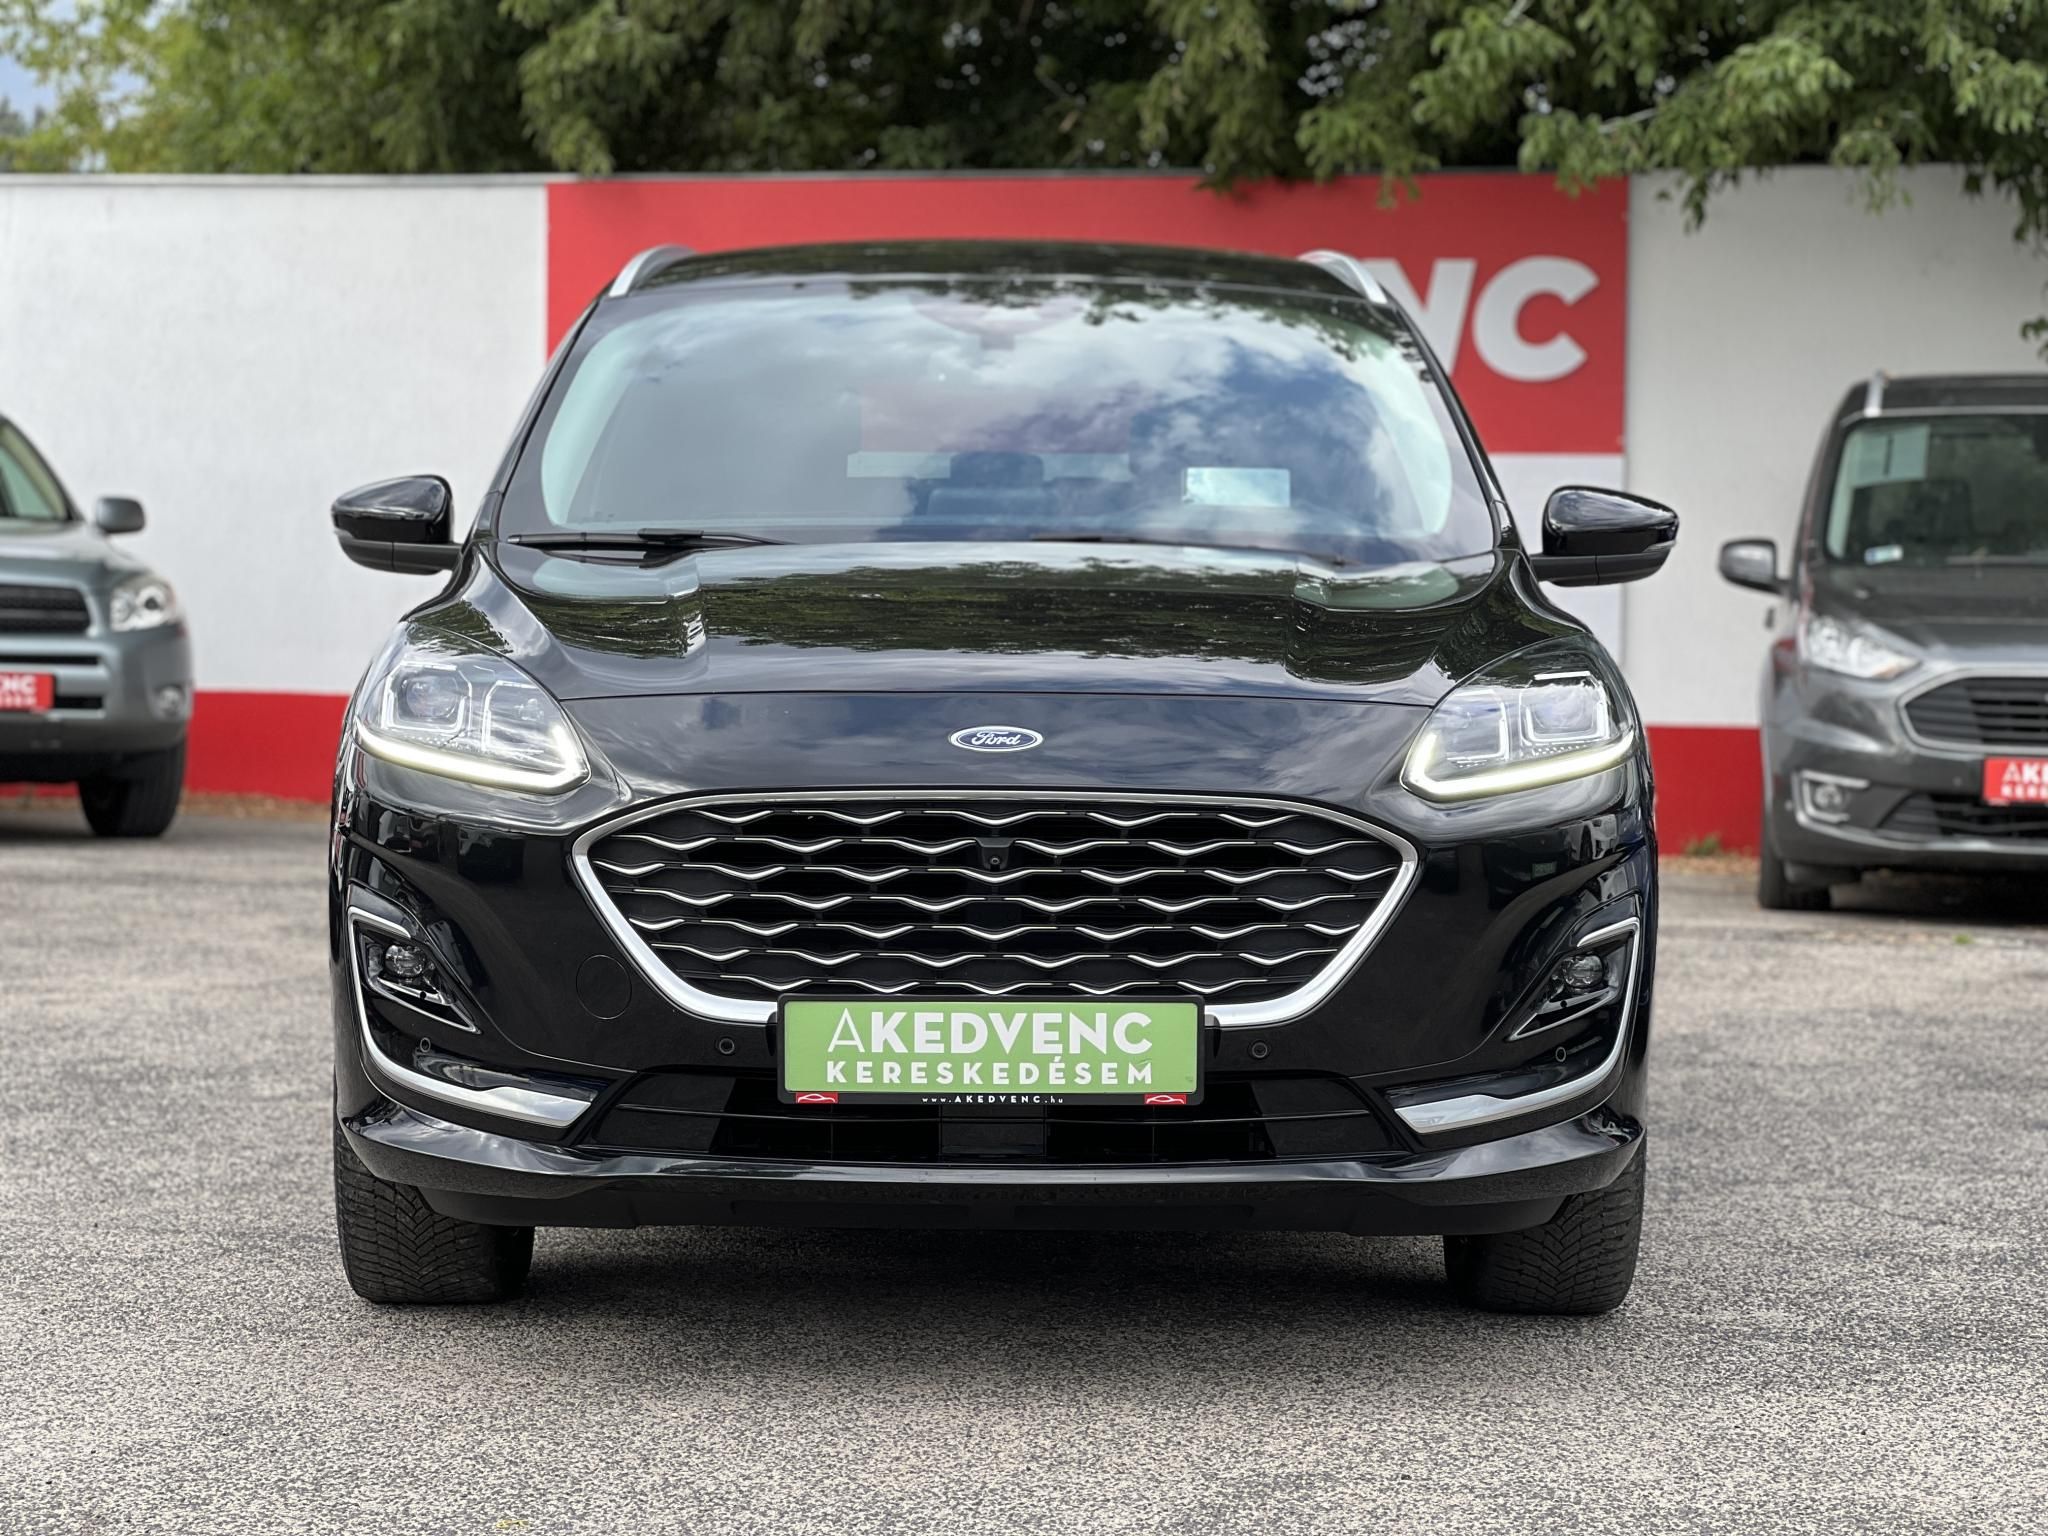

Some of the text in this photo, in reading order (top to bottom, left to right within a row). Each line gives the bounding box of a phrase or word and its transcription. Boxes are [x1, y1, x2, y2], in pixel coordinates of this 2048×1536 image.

[971, 731, 1021, 745] Ford
[827, 1007, 1153, 1055] AKEDVENC
[826, 1056, 1153, 1086] KERESKEDÉSEM
[922, 1095, 1064, 1104] www.AKEDVENC.hu
